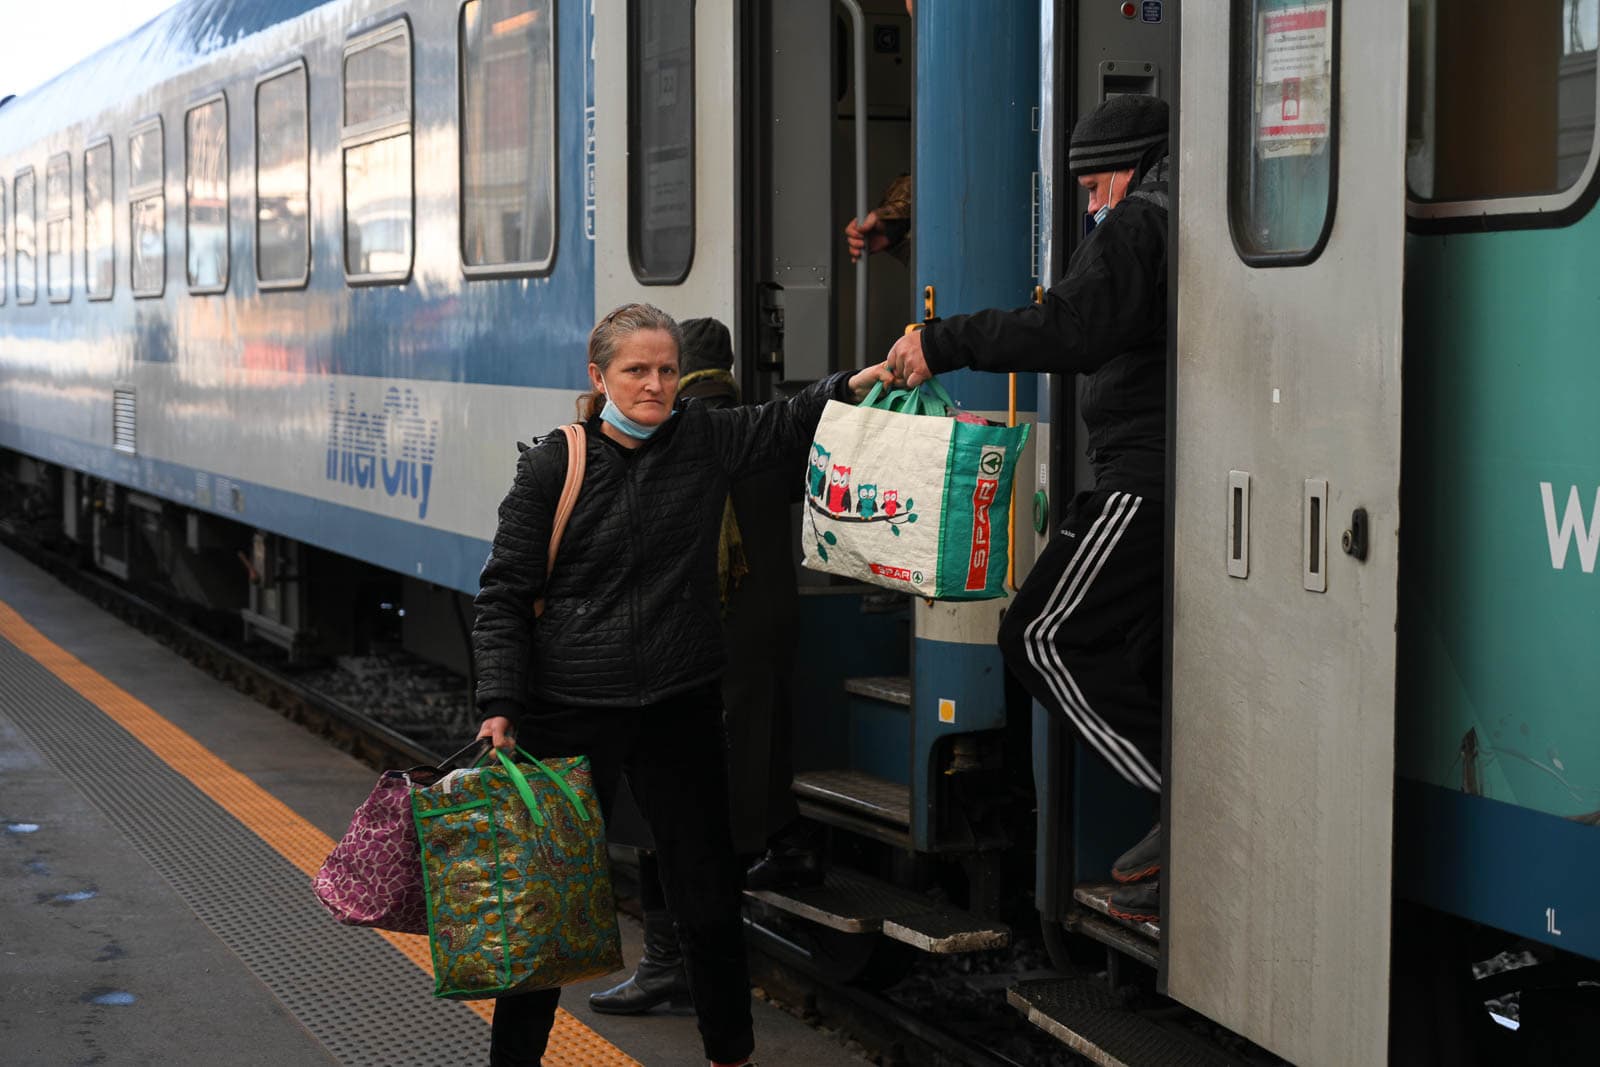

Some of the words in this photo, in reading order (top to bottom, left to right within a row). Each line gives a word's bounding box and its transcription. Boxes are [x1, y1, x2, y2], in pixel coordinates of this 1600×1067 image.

[326, 382, 439, 520] InterCity
[973, 481, 996, 569] SPAR
[1539, 481, 1600, 574] W
[877, 565, 911, 581] SPAR
